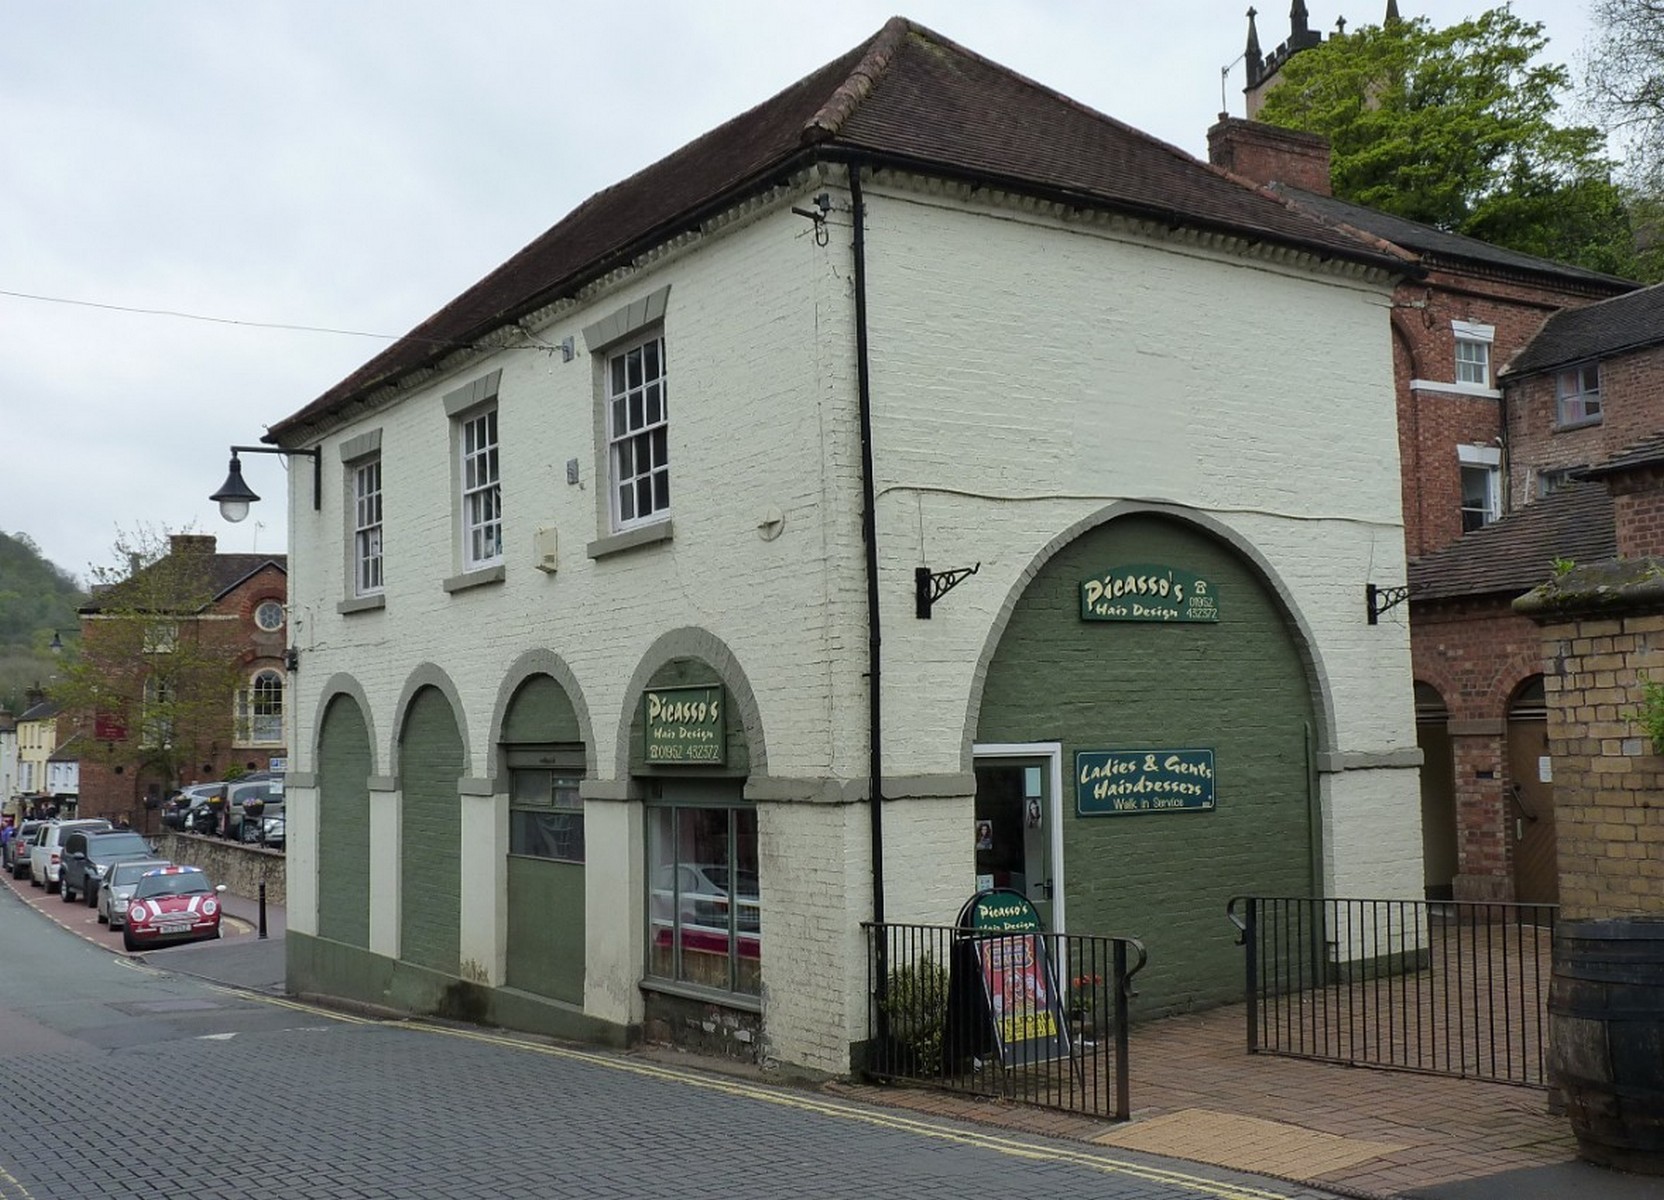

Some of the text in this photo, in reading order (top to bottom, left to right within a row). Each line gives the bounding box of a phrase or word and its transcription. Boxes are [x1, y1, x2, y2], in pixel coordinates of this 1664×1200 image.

[1085, 571, 1183, 617] Picasso's
[1096, 603, 1178, 620] Hair Design
[649, 690, 718, 725] Picasso's
[654, 727, 713, 742] Hair Design
[1081, 754, 1212, 784] Ladies & Gents
[1094, 775, 1202, 799] Hairdressers
[1113, 799, 1137, 810] Walk
[1153, 797, 1184, 808] Service
[978, 900, 1028, 920] Picasso's
